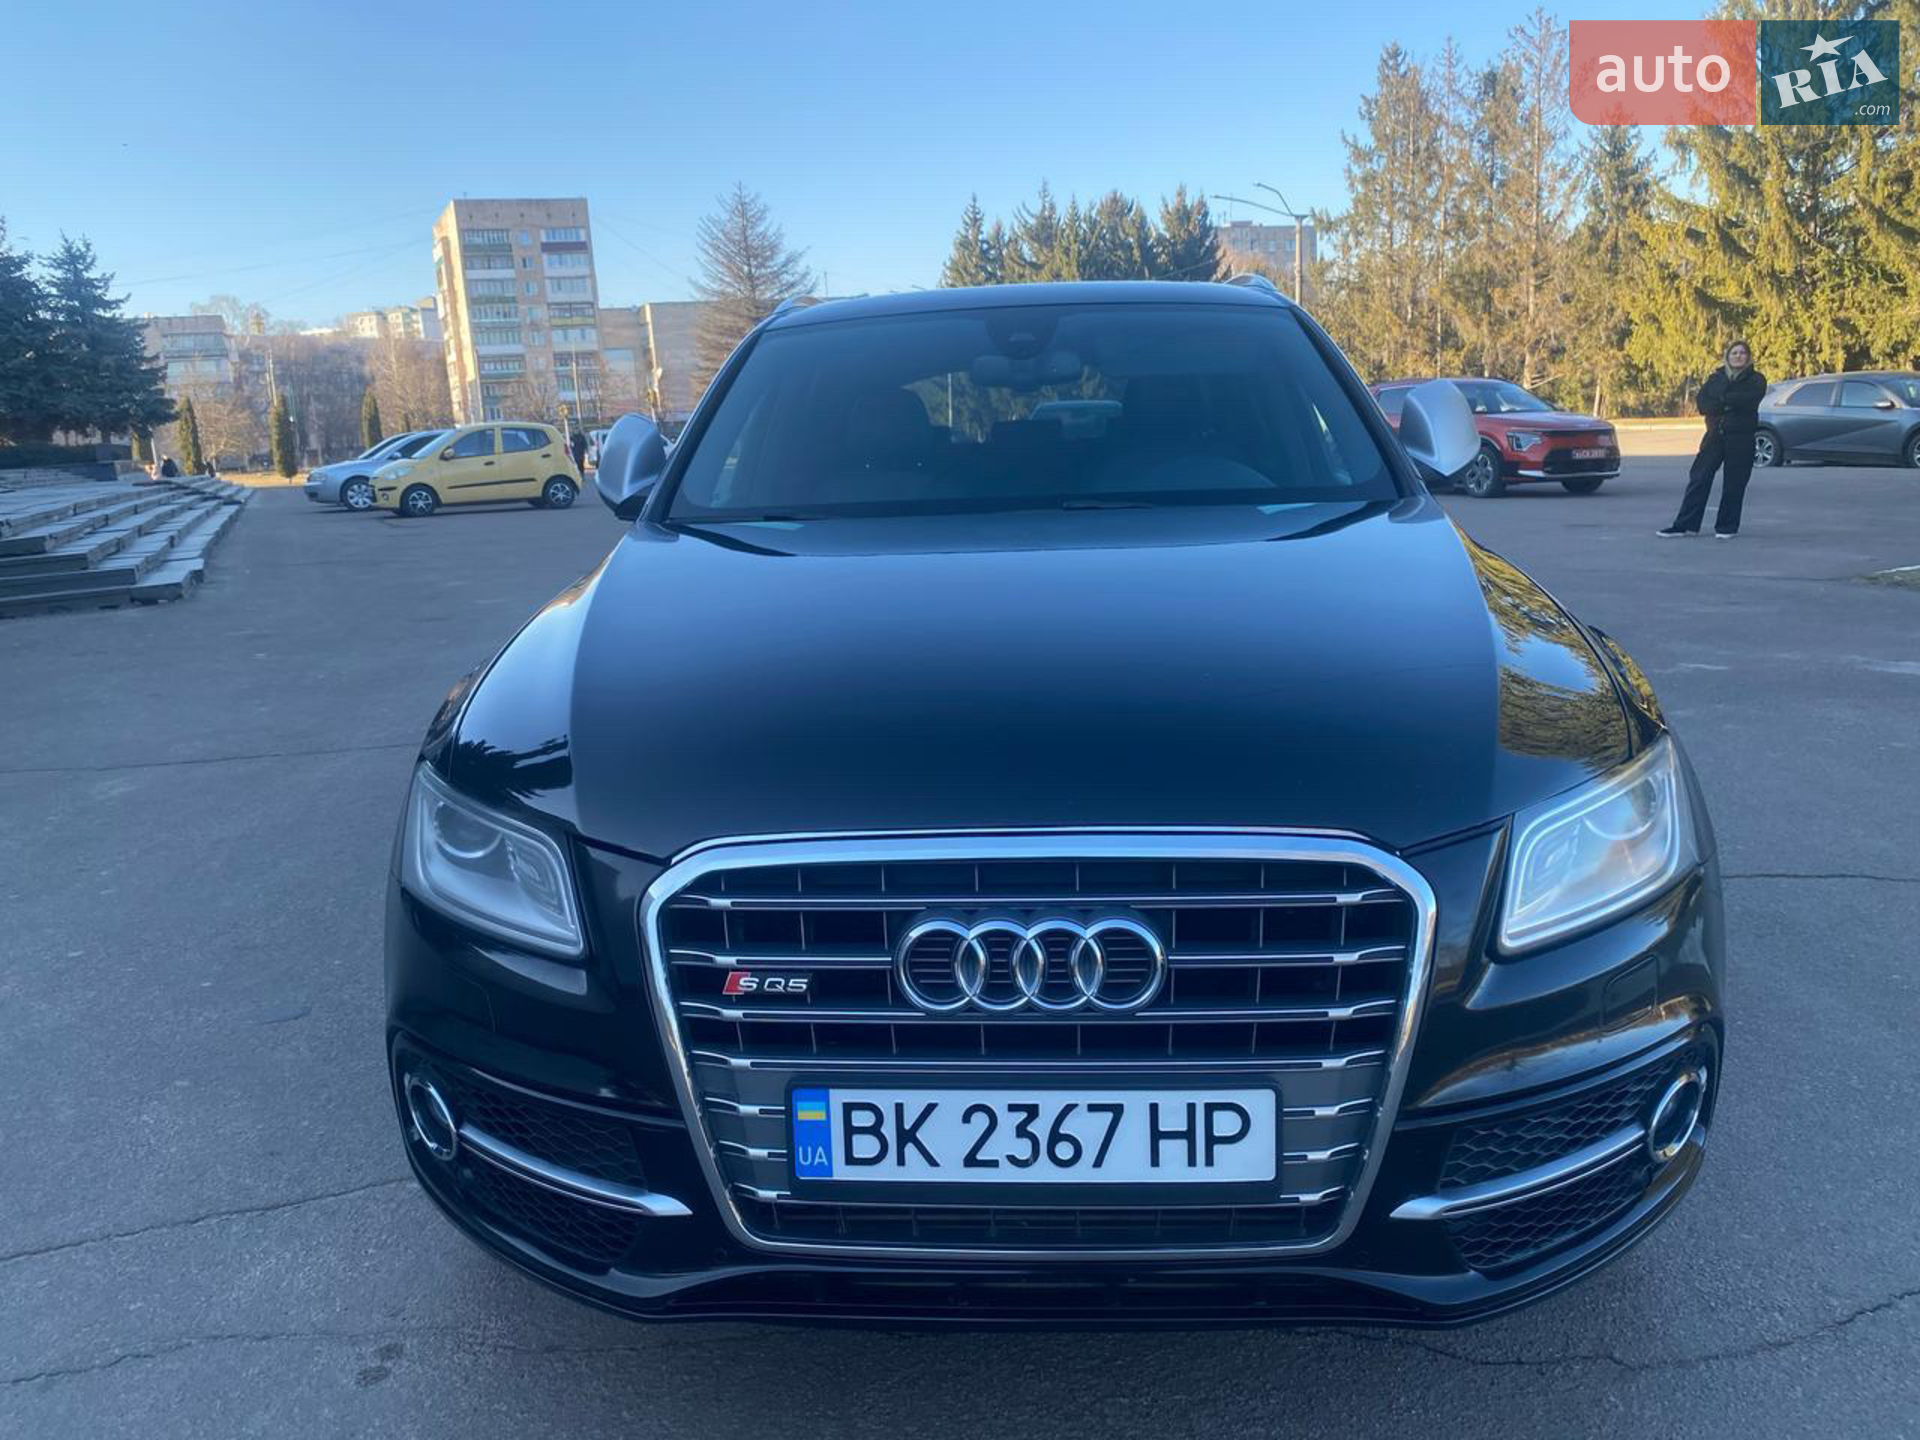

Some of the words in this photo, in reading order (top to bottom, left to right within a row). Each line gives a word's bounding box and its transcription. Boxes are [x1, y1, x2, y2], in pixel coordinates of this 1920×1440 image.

[738, 977, 808, 992] SQ5
[842, 1102, 940, 1167] BK
[961, 1103, 1124, 1168] 2367
[1149, 1102, 1251, 1168] HP
[799, 1146, 828, 1166] UA
